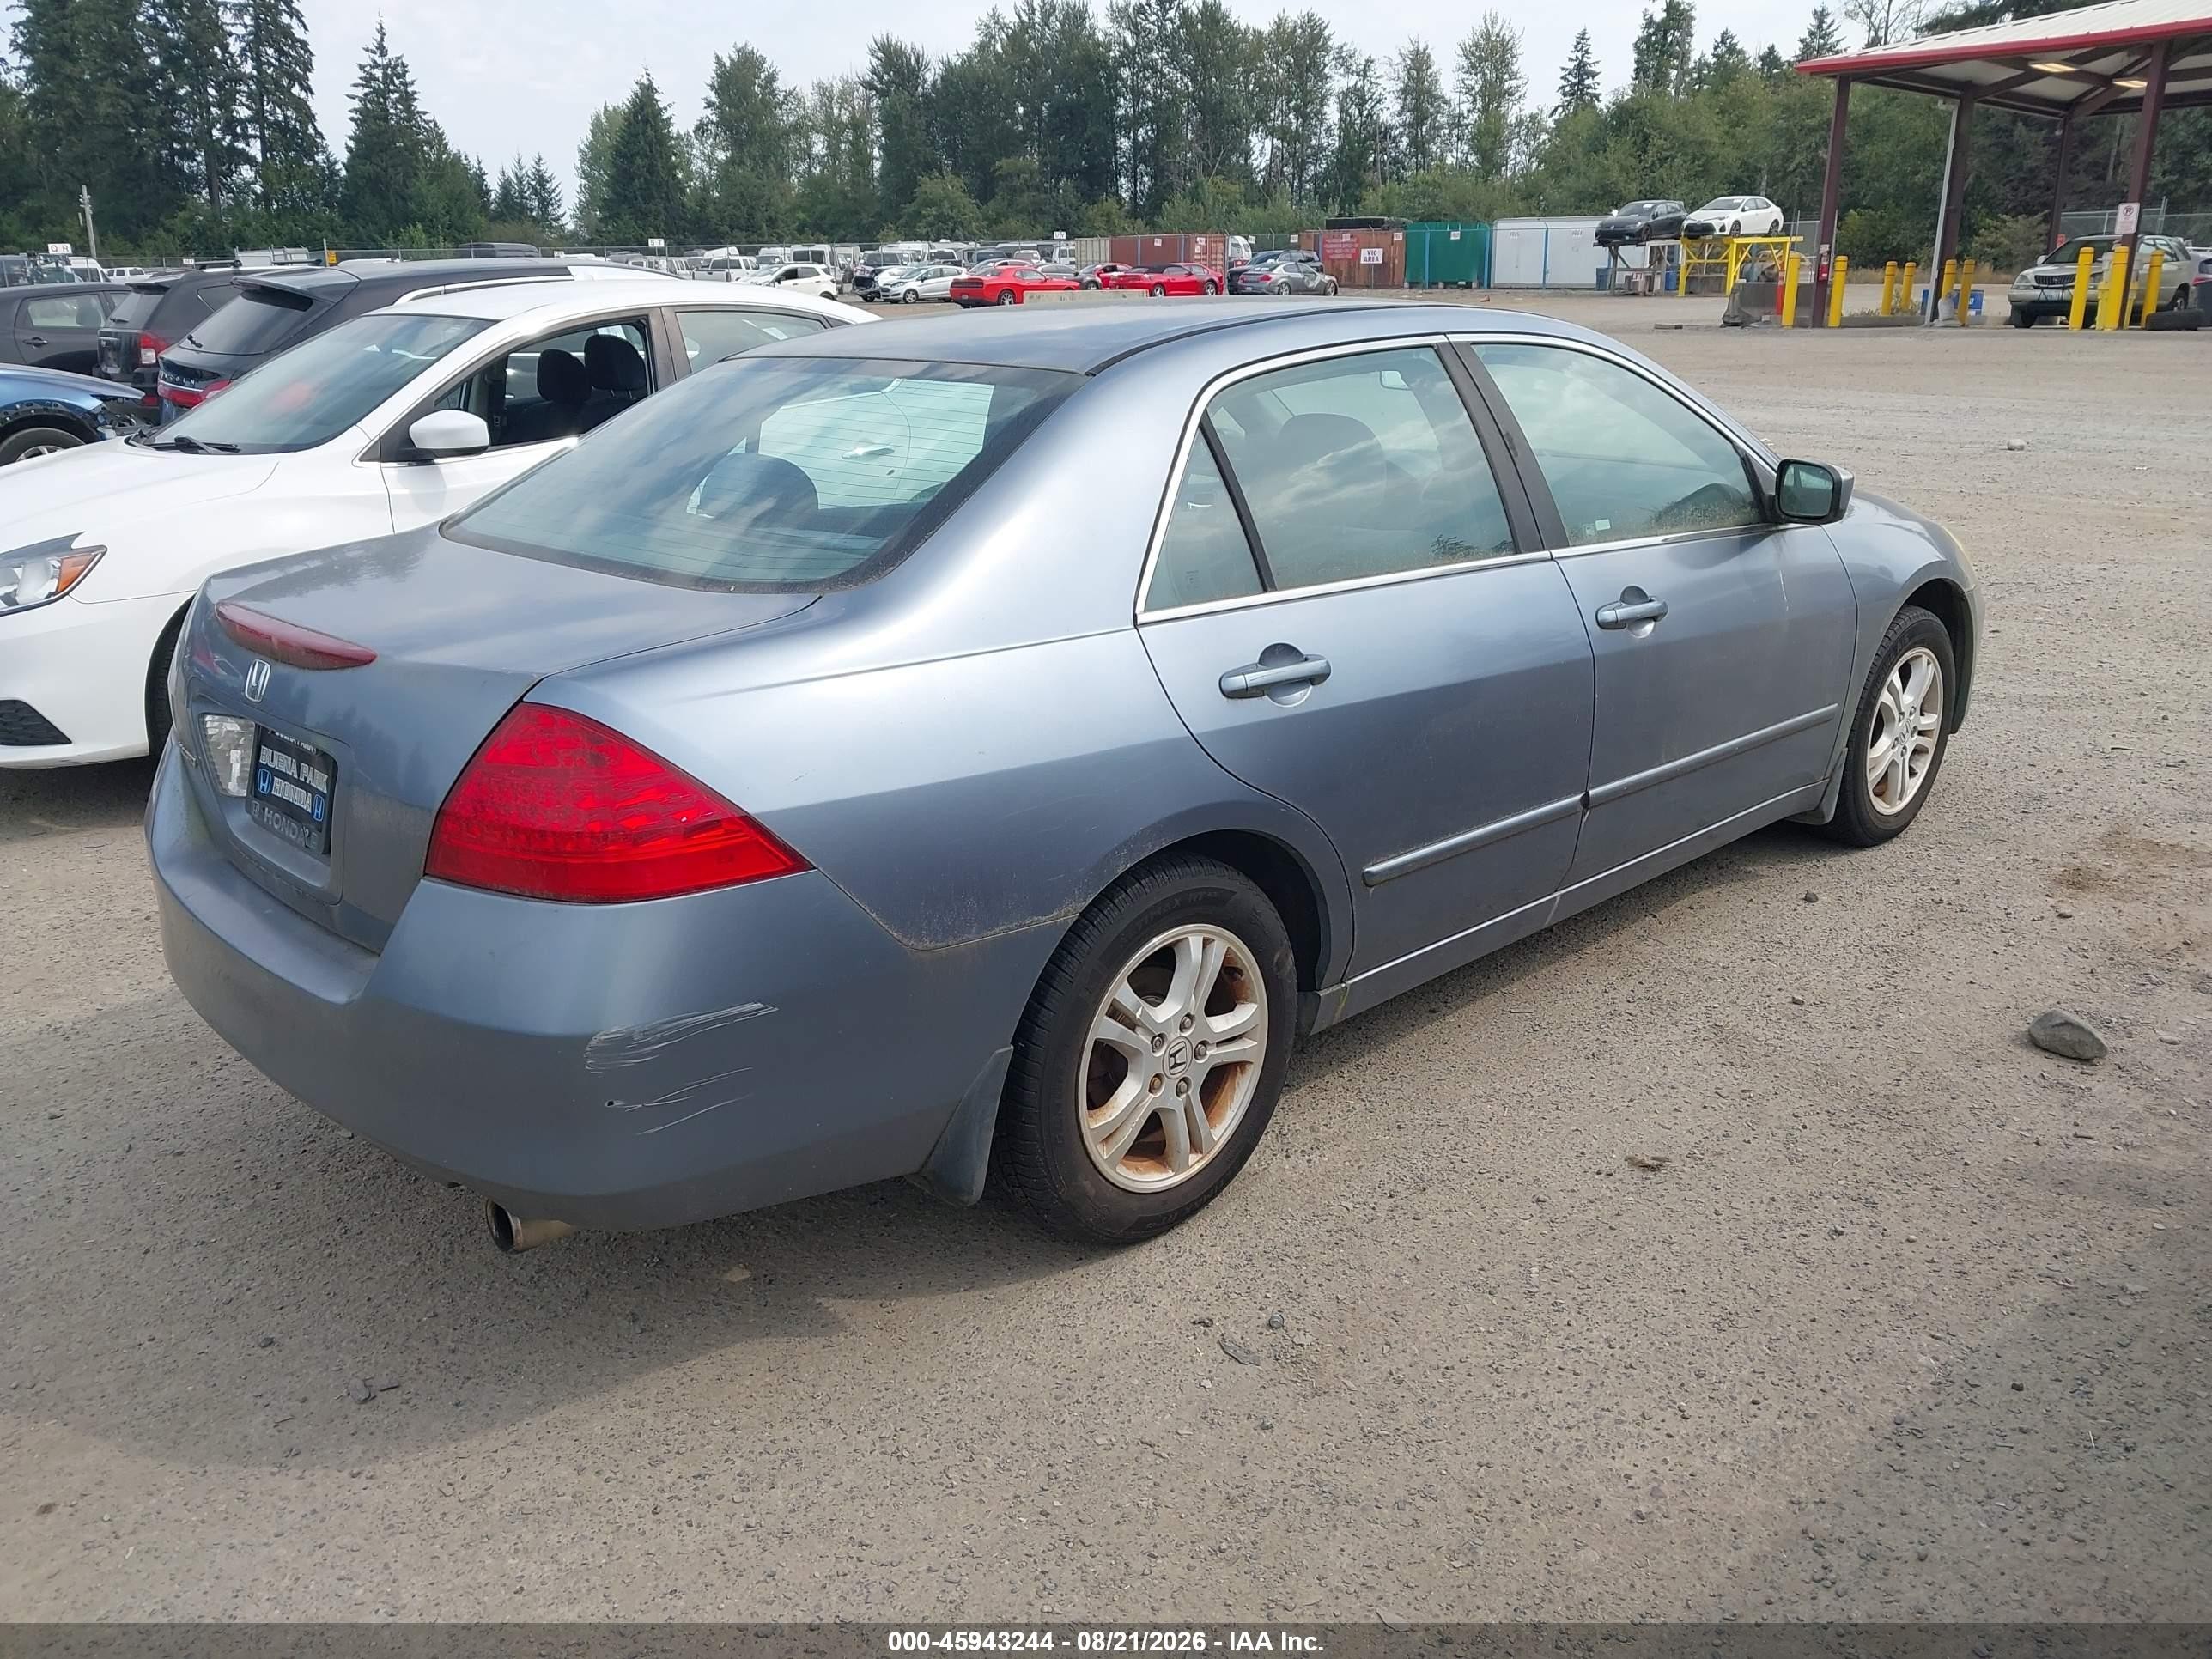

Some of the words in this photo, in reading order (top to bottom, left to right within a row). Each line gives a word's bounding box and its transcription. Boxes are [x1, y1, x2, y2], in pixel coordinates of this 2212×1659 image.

[259, 745, 298, 779] BUENA
[299, 763, 329, 793] PARK
[271, 776, 312, 814] HONDA
